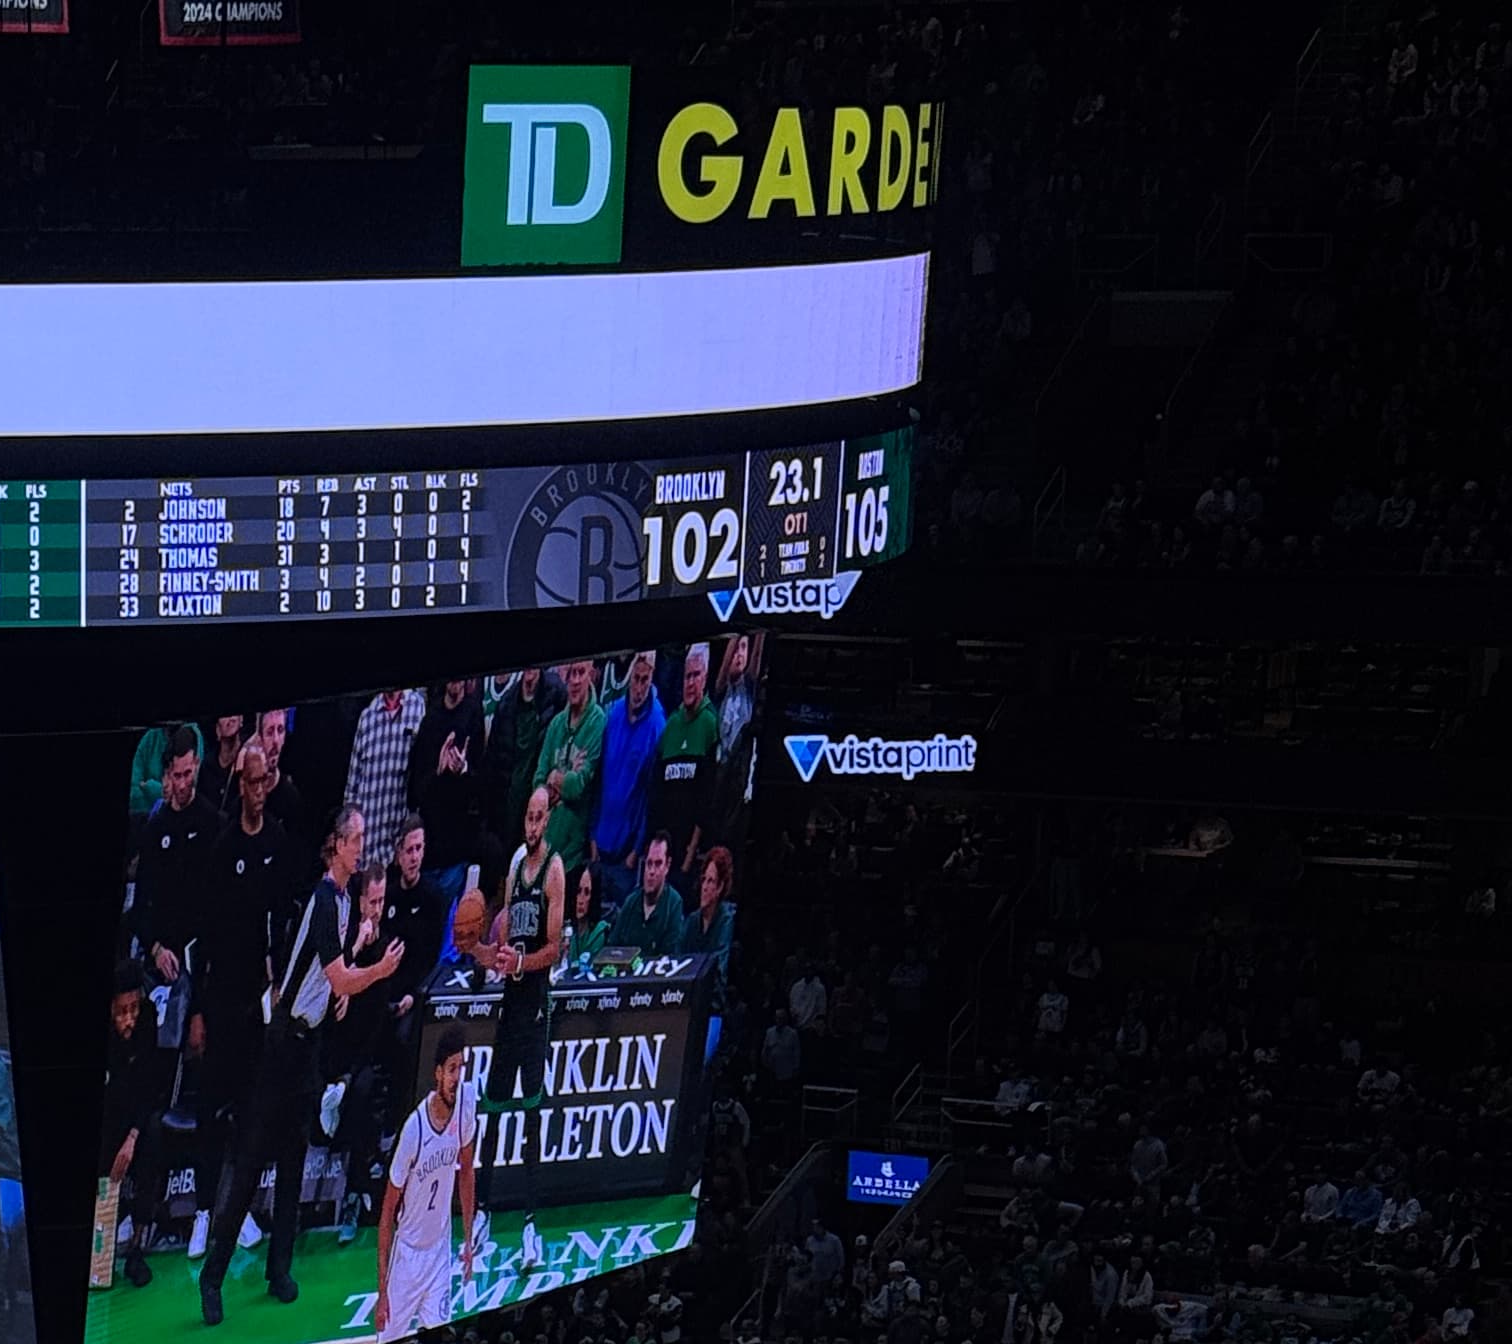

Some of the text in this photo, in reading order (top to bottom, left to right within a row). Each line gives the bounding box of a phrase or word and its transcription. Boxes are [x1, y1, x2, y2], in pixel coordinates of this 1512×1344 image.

[482, 102, 944, 225] TD GARDE
[25, 484, 47, 499] FLS
[159, 472, 479, 497] NETS PTS REB AST STL BLK FLS
[655, 470, 725, 505] BROOKLYN
[768, 457, 823, 506] 23.1
[124, 497, 294, 522] 2 JOHNSON 18
[845, 486, 889, 558] 105
[121, 520, 295, 546] 17 SCHRODER 20
[643, 508, 740, 585] 102
[119, 544, 293, 570] 24 THOMAS 31
[119, 569, 260, 594] 28 FINNEY-SMITH
[119, 590, 331, 618] 33 CLAXTON 10
[830, 738, 975, 777] vistaprint
[428, 1179, 439, 1210] 2
